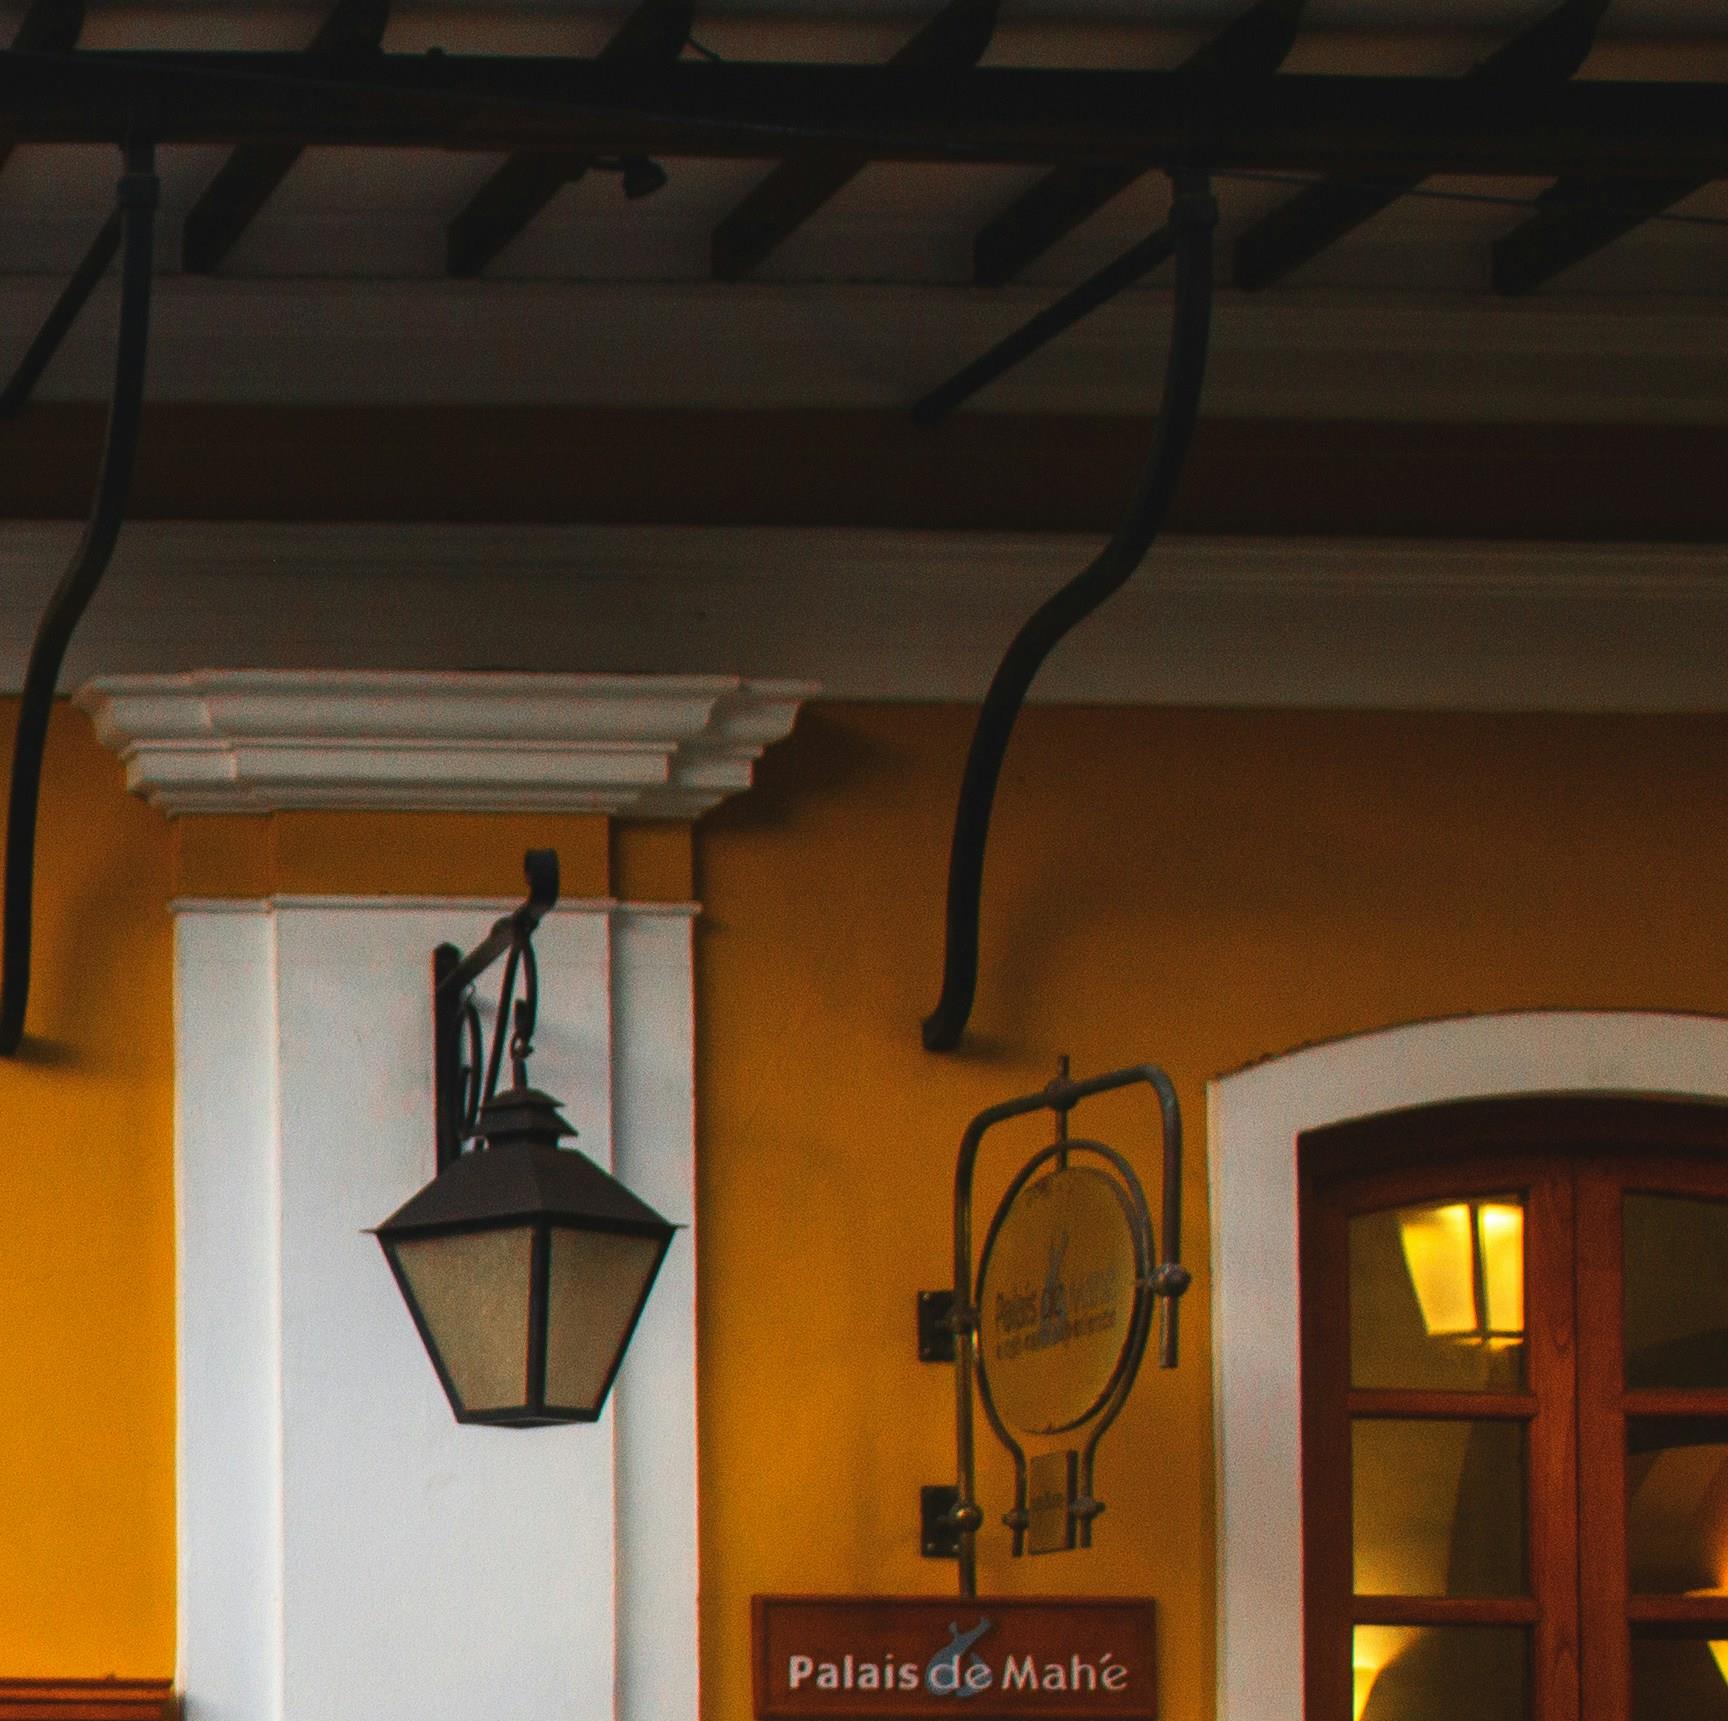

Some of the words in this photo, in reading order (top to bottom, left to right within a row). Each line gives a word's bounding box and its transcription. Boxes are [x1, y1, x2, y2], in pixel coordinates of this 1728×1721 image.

[788, 1654, 920, 1690] Palais
[930, 1655, 994, 1691] de
[1001, 1651, 1129, 1691] Mahé
